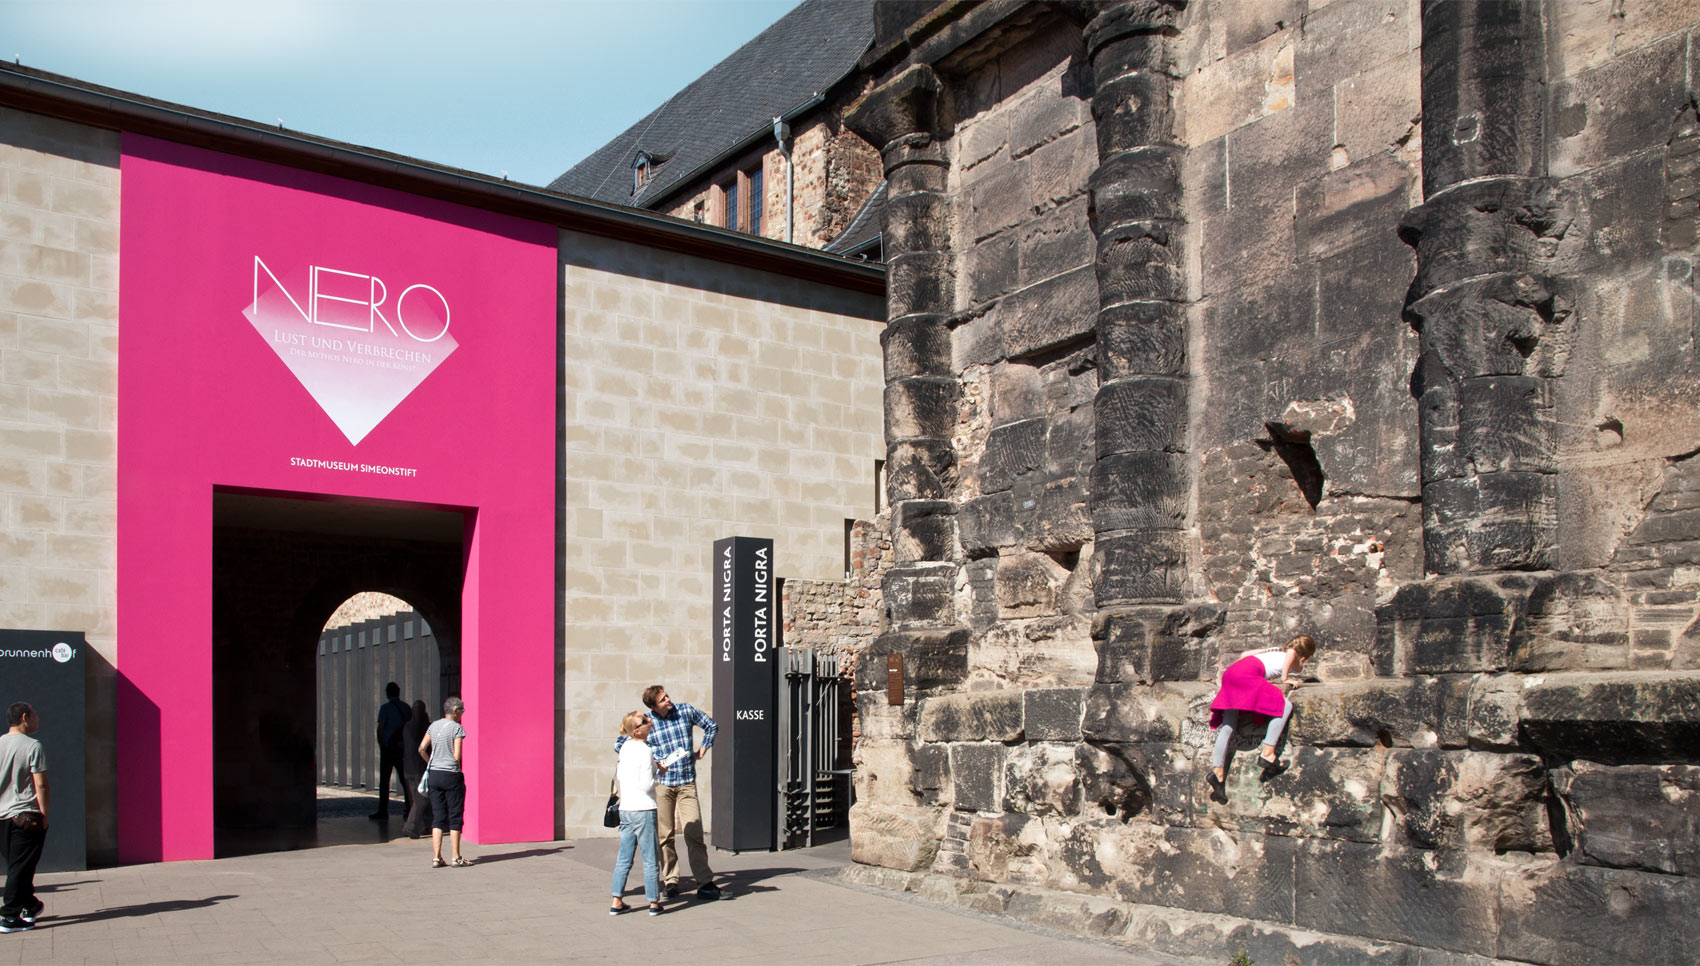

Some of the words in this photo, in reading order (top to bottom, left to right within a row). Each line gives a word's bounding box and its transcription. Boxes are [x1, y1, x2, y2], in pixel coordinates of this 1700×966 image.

[253, 255, 450, 342] NERO
[274, 329, 307, 346] LUST
[311, 336, 343, 351] UND
[347, 340, 431, 364] VERBRECHEN
[290, 347, 307, 357] DER
[290, 457, 359, 472] STADTMUSEUM
[360, 464, 417, 477] SIMEONSTIFT
[723, 545, 732, 601] NIGRA
[755, 547, 768, 602] NIGRA
[723, 606, 731, 662] PORTA
[754, 607, 767, 662] PORTA
[736, 710, 764, 720] KASSE
